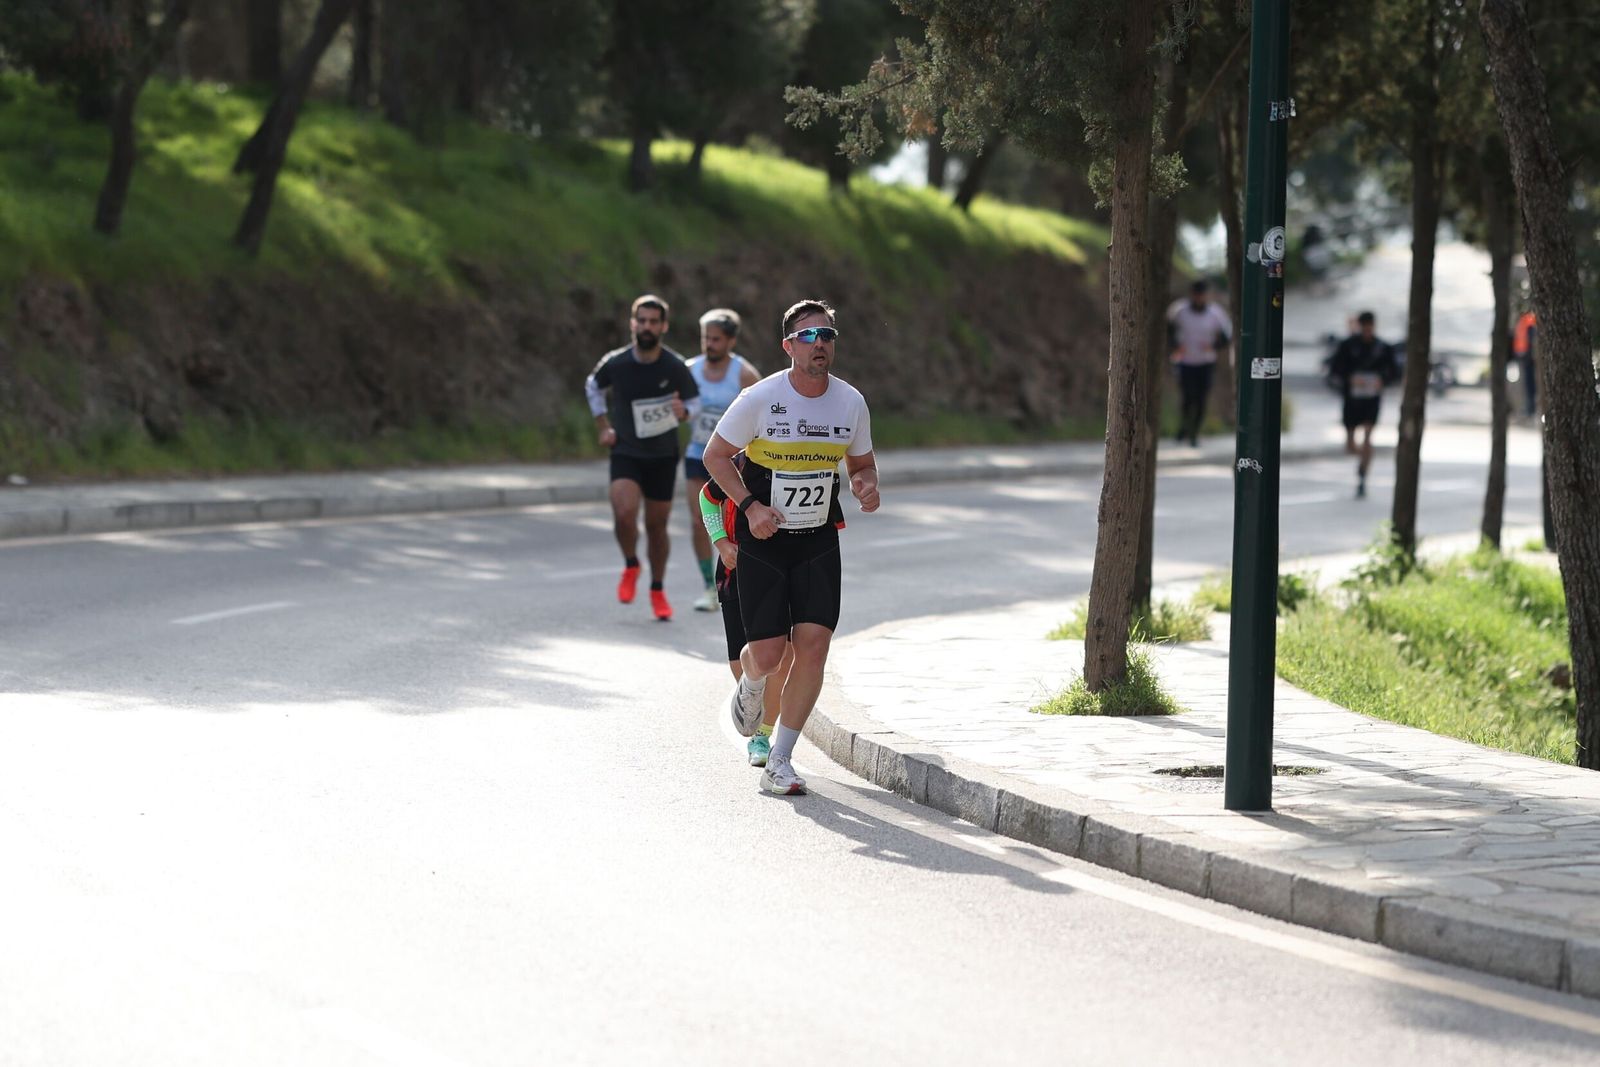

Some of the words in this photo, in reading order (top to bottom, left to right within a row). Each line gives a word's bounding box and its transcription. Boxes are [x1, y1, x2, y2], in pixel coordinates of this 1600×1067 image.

[763, 450, 783, 460] CLUB
[785, 452, 828, 461] TRIATLÓN
[783, 485, 825, 507] 722
